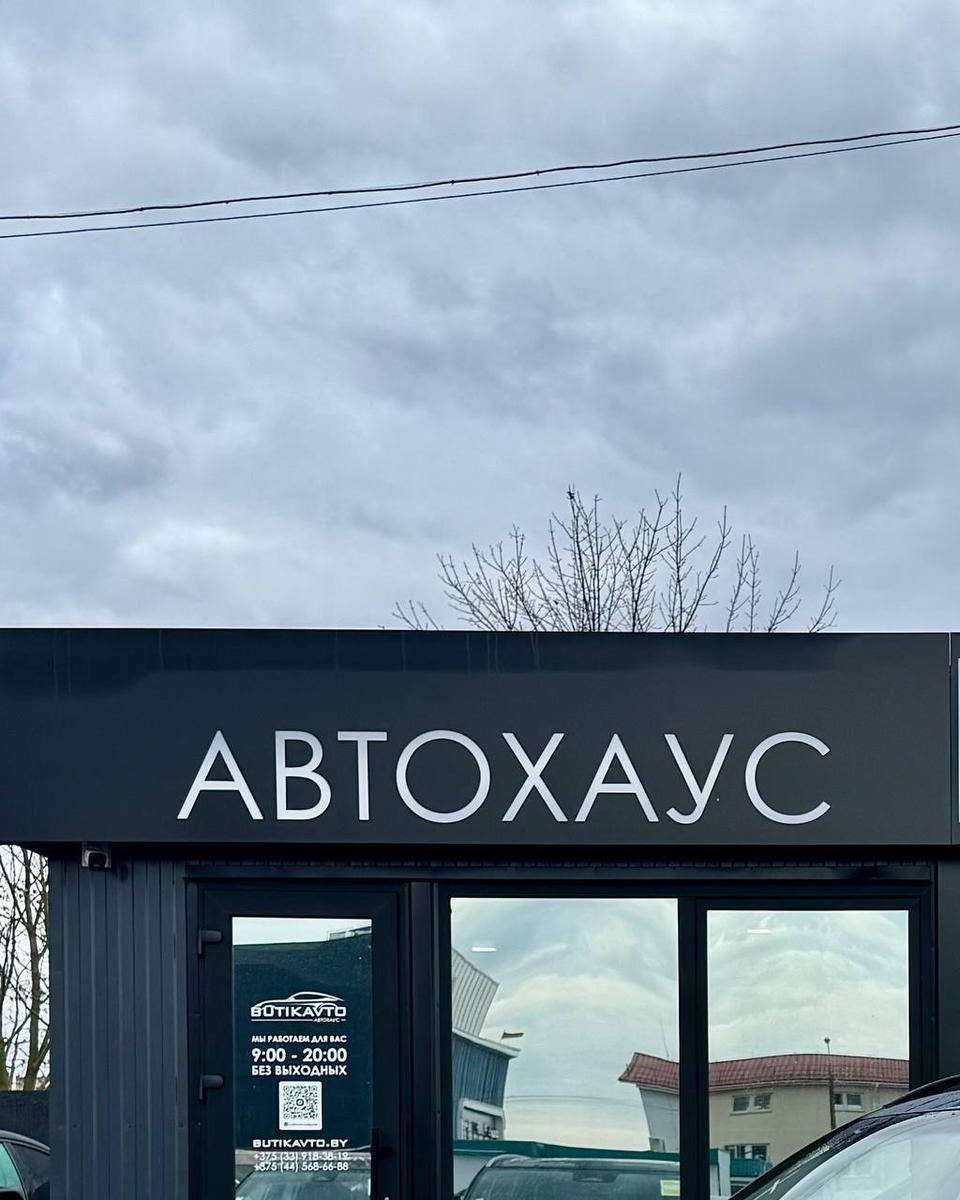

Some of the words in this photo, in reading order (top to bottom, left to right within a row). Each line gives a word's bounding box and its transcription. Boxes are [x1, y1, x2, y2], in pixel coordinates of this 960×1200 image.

[177, 729, 831, 825] АВТОХАУС
[251, 1006, 347, 1017] BUTIKAVTO
[252, 1035, 266, 1043] МЫ
[268, 1035, 310, 1043] РАБОТАЕМ
[311, 1035, 329, 1043] ДЛЯ
[330, 1035, 347, 1043] ВАС
[251, 1047, 286, 1062] 9:00
[302, 1047, 348, 1062] 20:00
[251, 1065, 272, 1076] БЕЗ
[275, 1065, 347, 1076] ВЫХОДНЫХ
[252, 1139, 348, 1148] BUTIKAVTO.BY
[254, 1151, 277, 1161] +375
[280, 1151, 298, 1162] (33)
[280, 1161, 298, 1173] (44)
[301, 1162, 349, 1171] 568-66-88
